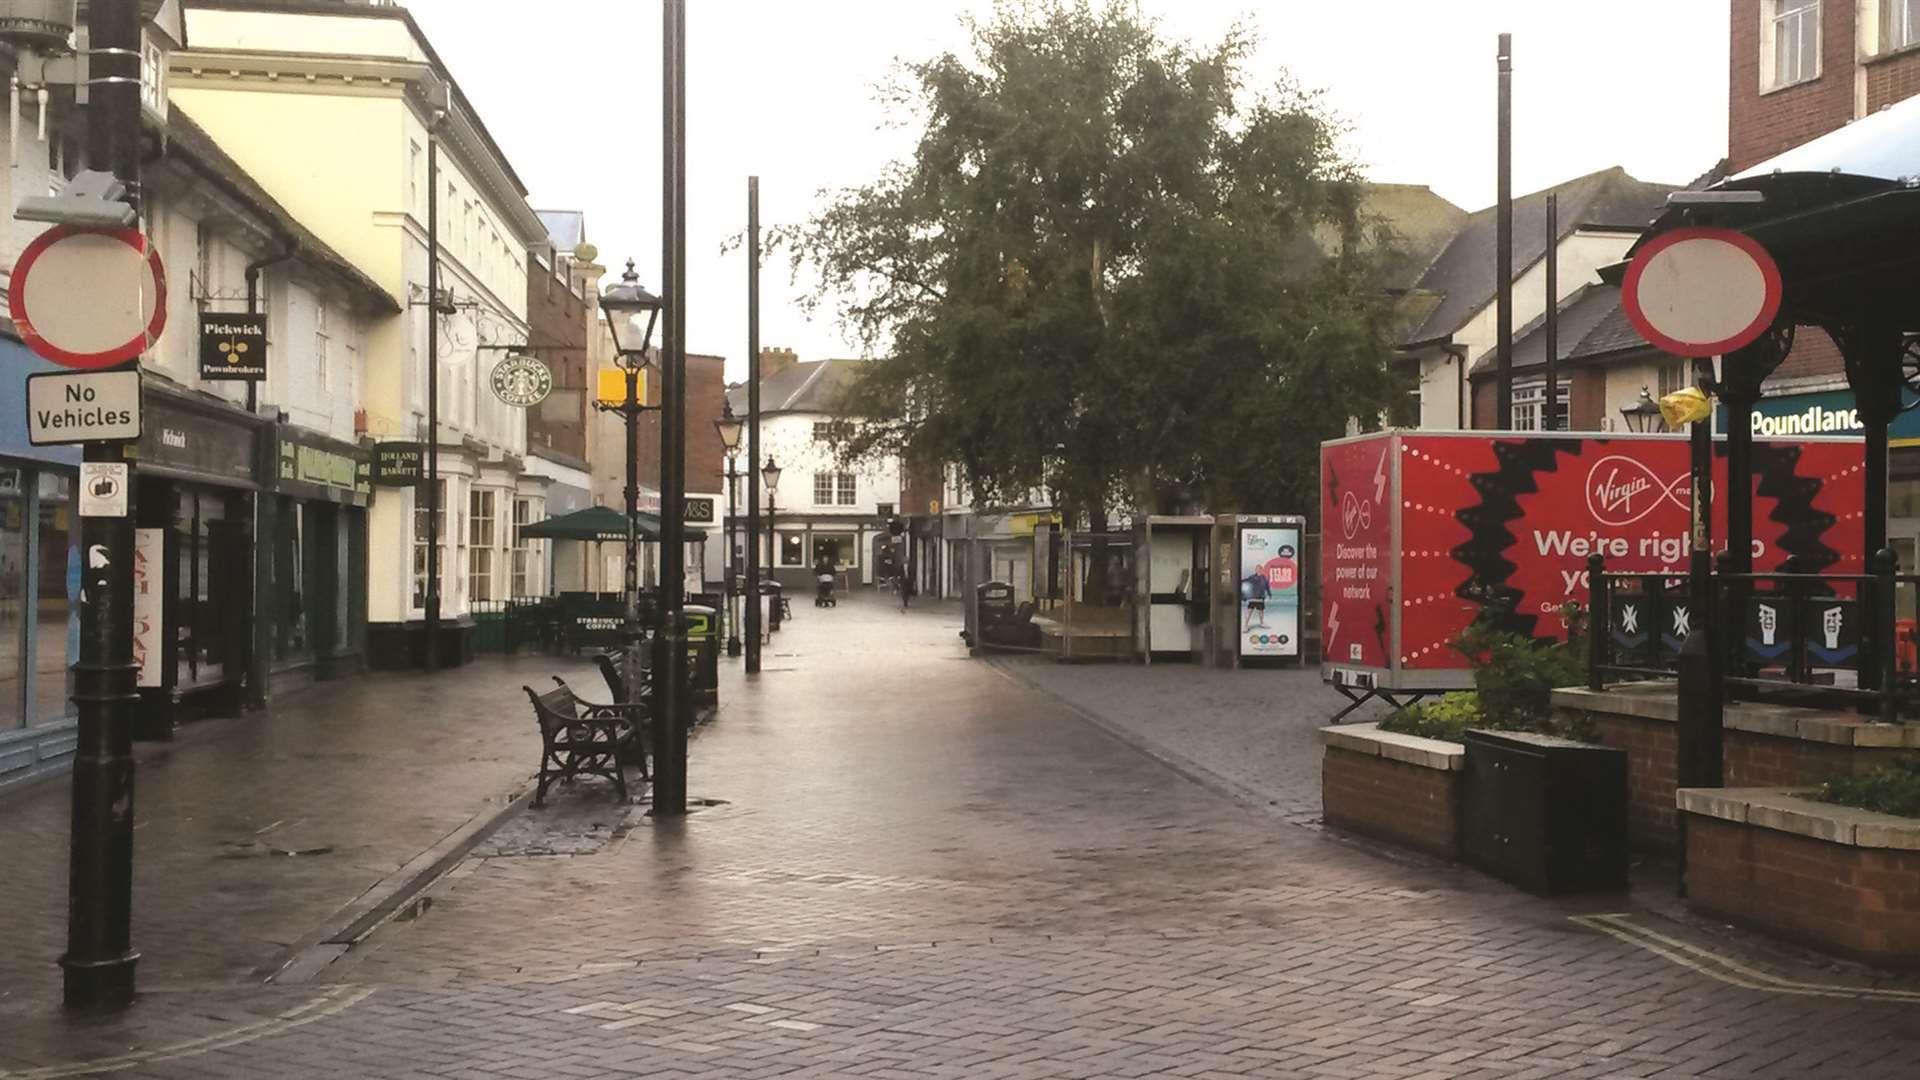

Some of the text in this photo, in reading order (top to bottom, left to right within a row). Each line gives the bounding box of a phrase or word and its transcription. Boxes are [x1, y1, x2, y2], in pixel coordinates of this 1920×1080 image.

[204, 323, 262, 335] Pickwick
[203, 364, 264, 373] Pawnbrokers
[495, 360, 551, 381] STARBUCKS
[66, 383, 96, 402] No
[500, 390, 541, 403] COFFEE
[38, 407, 131, 429] Vehicles
[1595, 468, 1651, 513] Virgin
[1336, 543, 1377, 559] Discover the
[1533, 530, 1629, 557] We're
[1336, 563, 1378, 582] power of our
[1343, 583, 1371, 599] network
[576, 617, 625, 625] STARBUCKS
